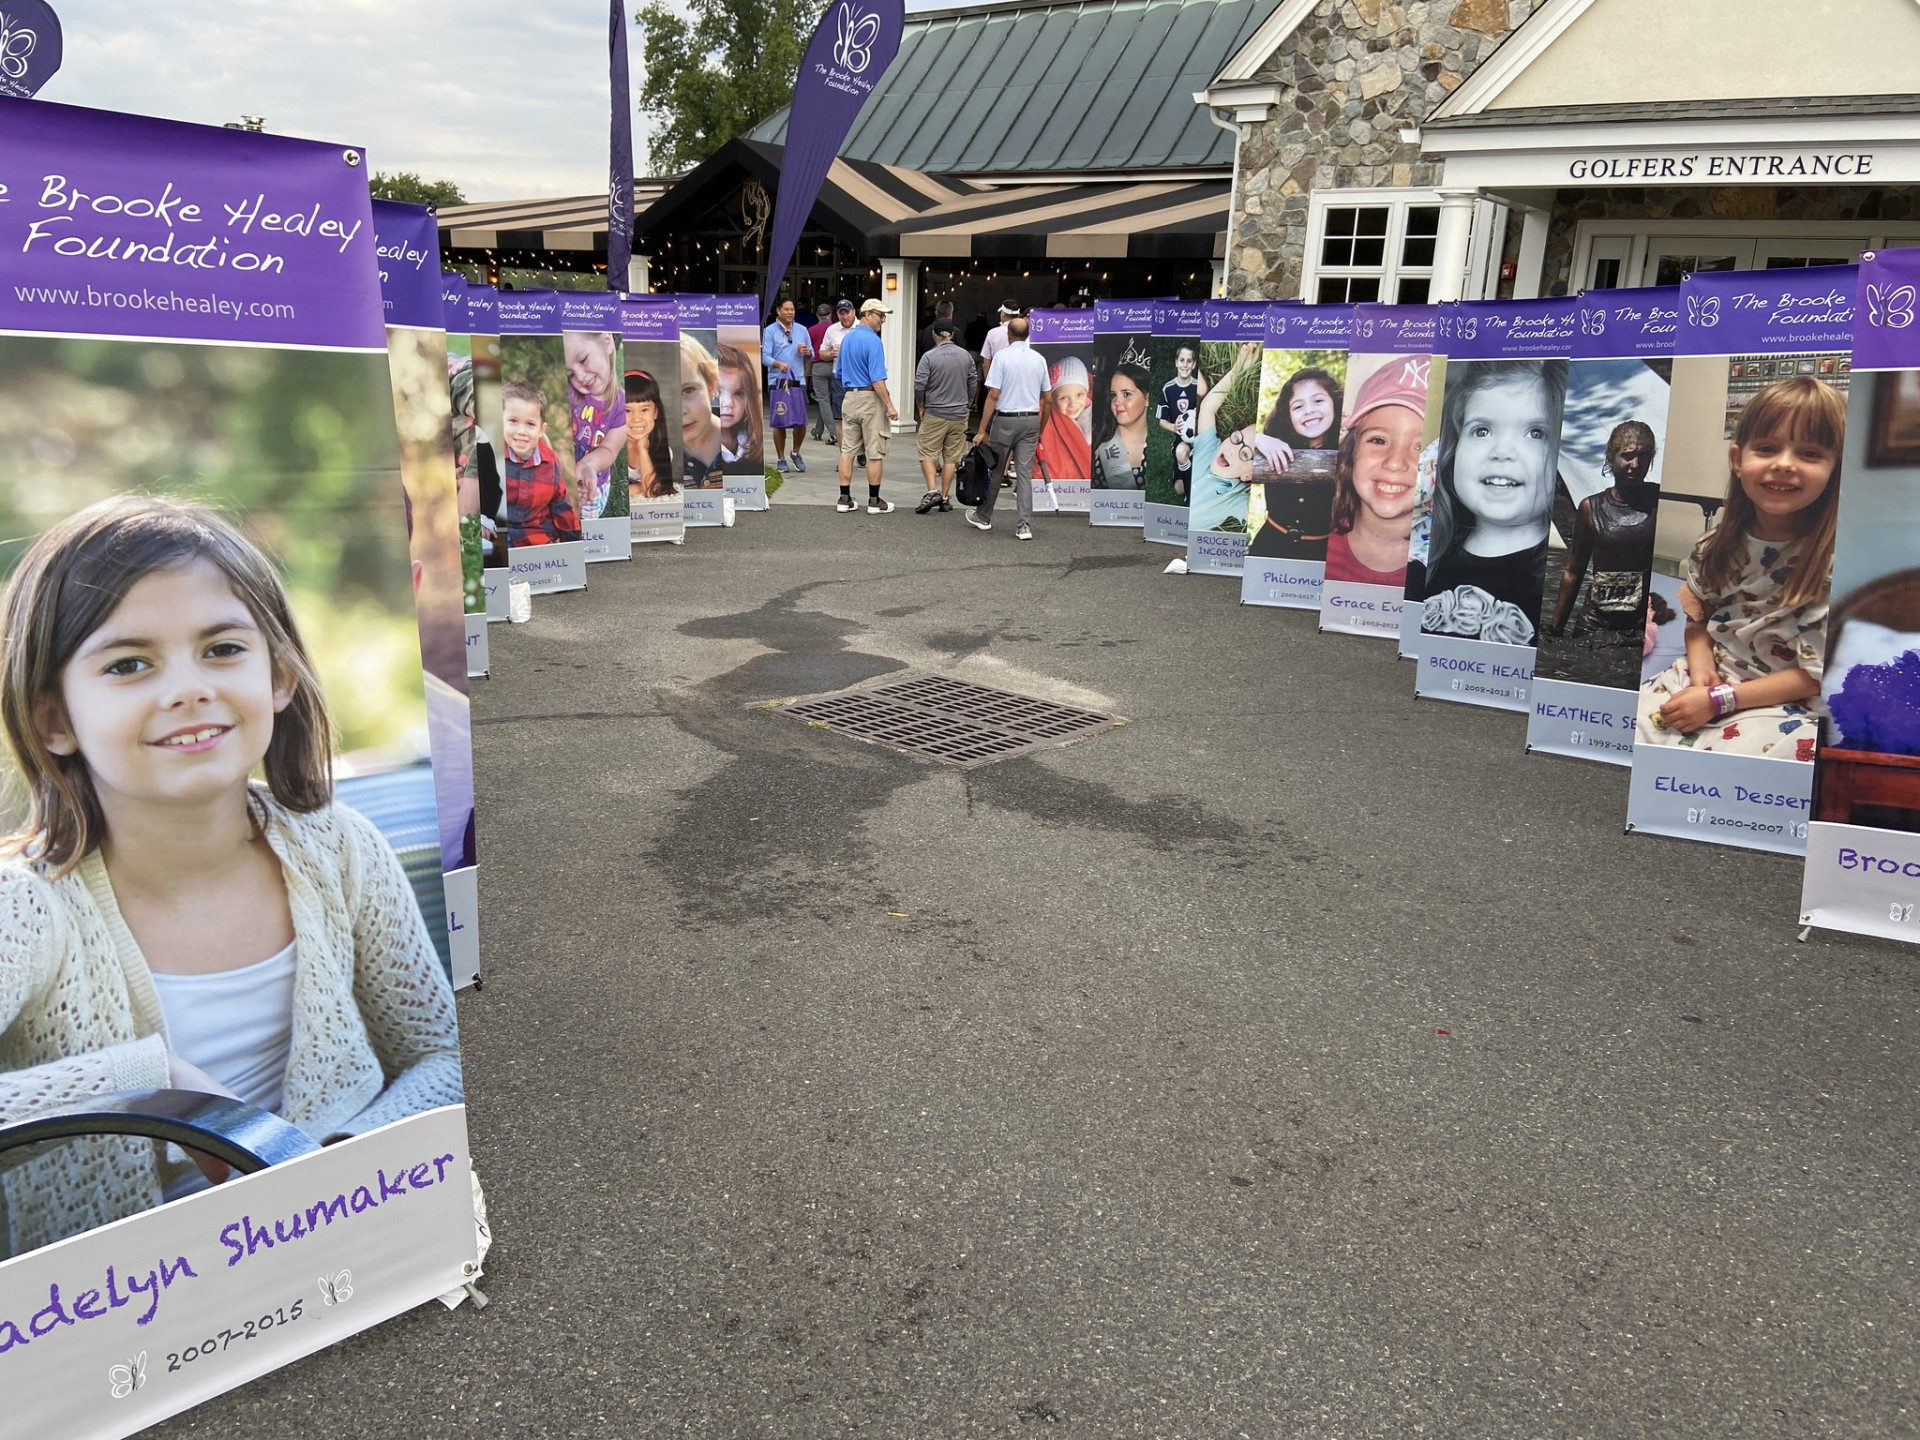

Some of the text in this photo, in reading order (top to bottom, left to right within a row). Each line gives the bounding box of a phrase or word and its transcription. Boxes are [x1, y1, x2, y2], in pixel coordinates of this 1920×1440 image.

[815, 64, 827, 75] The
[829, 68, 851, 81] Brooke
[824, 77, 859, 96] Foundation
[1569, 154, 1873, 179] GOLFERS' ENTRANCE
[38, 174, 362, 253] Brooke Healey
[22, 216, 284, 274] Foundation
[375, 234, 428, 270] ealey
[14, 284, 295, 320] www.brookehealey.com
[468, 297, 494, 311] ealey
[1732, 288, 1846, 310] The Brooke
[499, 310, 541, 320] oundation
[529, 302, 556, 313] Healey
[562, 309, 604, 319] Foundation
[564, 302, 617, 314] Brooke Healey
[1128, 307, 1151, 315] Brooke
[1167, 309, 1178, 317] The
[1614, 307, 1642, 321] The
[621, 310, 678, 322] Brooke Healey
[1063, 317, 1087, 325] Brooke
[1223, 311, 1267, 320] The Brook
[1291, 316, 1308, 326] The
[1312, 315, 1344, 326] Brooke
[1379, 317, 1436, 328] The Brooke
[1484, 315, 1507, 328] The
[1512, 313, 1555, 327] Brooke
[1767, 307, 1856, 325] Foundati
[1094, 501, 1130, 509] CHARLIE
[648, 511, 680, 520] Torres
[1157, 517, 1173, 526] Kohl
[1197, 536, 1229, 546] BRUCE
[509, 559, 568, 574] ARSON HALL
[1330, 596, 1375, 611] Grace
[1430, 657, 1486, 674] BROOKE
[1465, 684, 1510, 697] 2008-2013
[1537, 702, 1613, 728] HEATHER
[1588, 738, 1633, 753] 1998-201
[1654, 776, 1810, 810] Elena Desser
[1710, 816, 1783, 834] 2000-2007
[219, 1152, 455, 1267] Shumaker
[167, 1299, 303, 1372] 2007-2015
